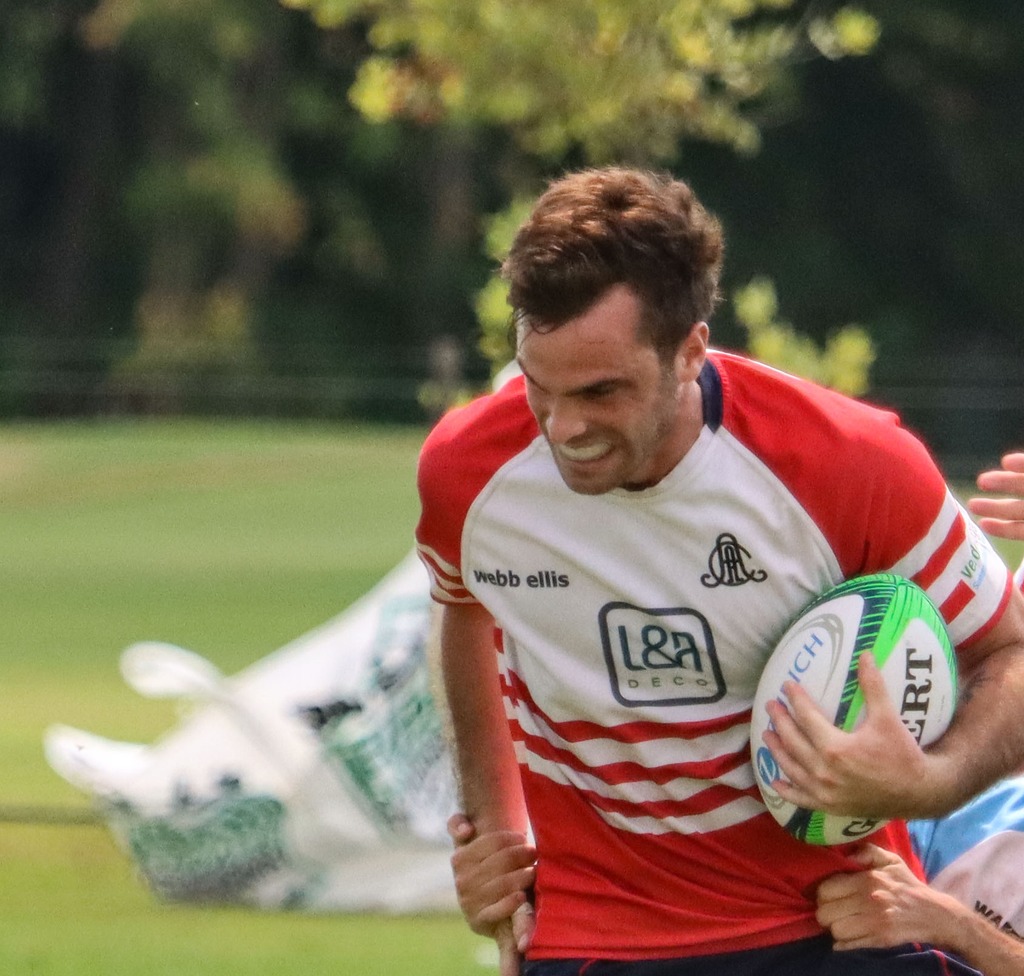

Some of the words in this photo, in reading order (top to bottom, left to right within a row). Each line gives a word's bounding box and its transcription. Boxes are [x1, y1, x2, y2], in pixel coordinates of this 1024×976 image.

[473, 569, 521, 587] webb
[526, 570, 570, 588] ellis
[627, 676, 708, 689] DECO
